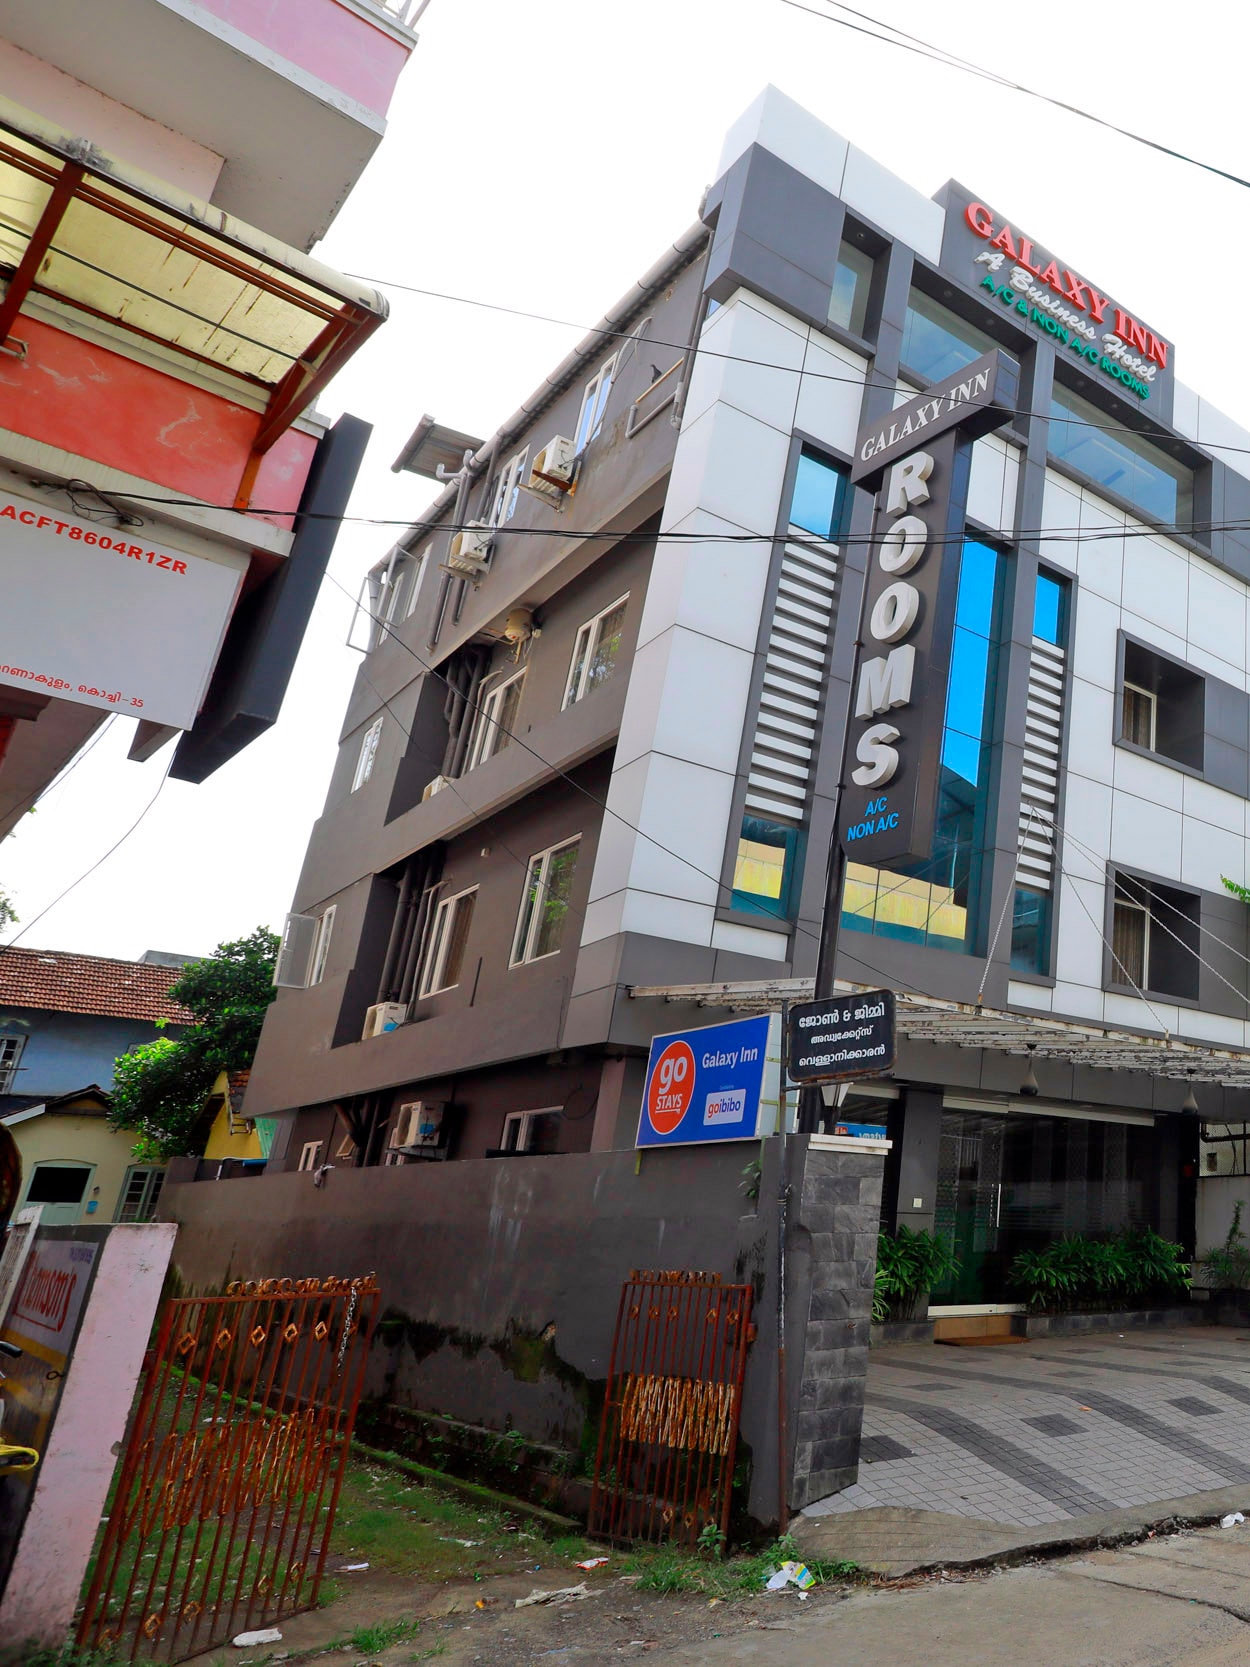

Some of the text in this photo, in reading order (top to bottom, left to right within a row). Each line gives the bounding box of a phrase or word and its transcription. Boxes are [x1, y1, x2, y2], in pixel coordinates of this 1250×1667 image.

[964, 202, 1169, 369] GALAXY INN
[974, 251, 1156, 383] A Business Hotel
[980, 275, 1151, 400] A/C & NON A/C ROOMS
[860, 369, 991, 462] GALAXY INN
[0, 505, 188, 575] ACFT8604R1ZR
[851, 450, 934, 790] ROOMS
[0, 664, 73, 692] റണാകുളം,
[865, 796, 887, 817] A/C
[847, 811, 899, 843] NON A/C
[843, 1010, 851, 1022] &
[854, 1002, 885, 1020] ജിമ്മി
[658, 1056, 688, 1094] go
[702, 1047, 758, 1069] Galaxy Inn
[655, 1093, 683, 1111] STAYS
[708, 1097, 741, 1118] goibibo
